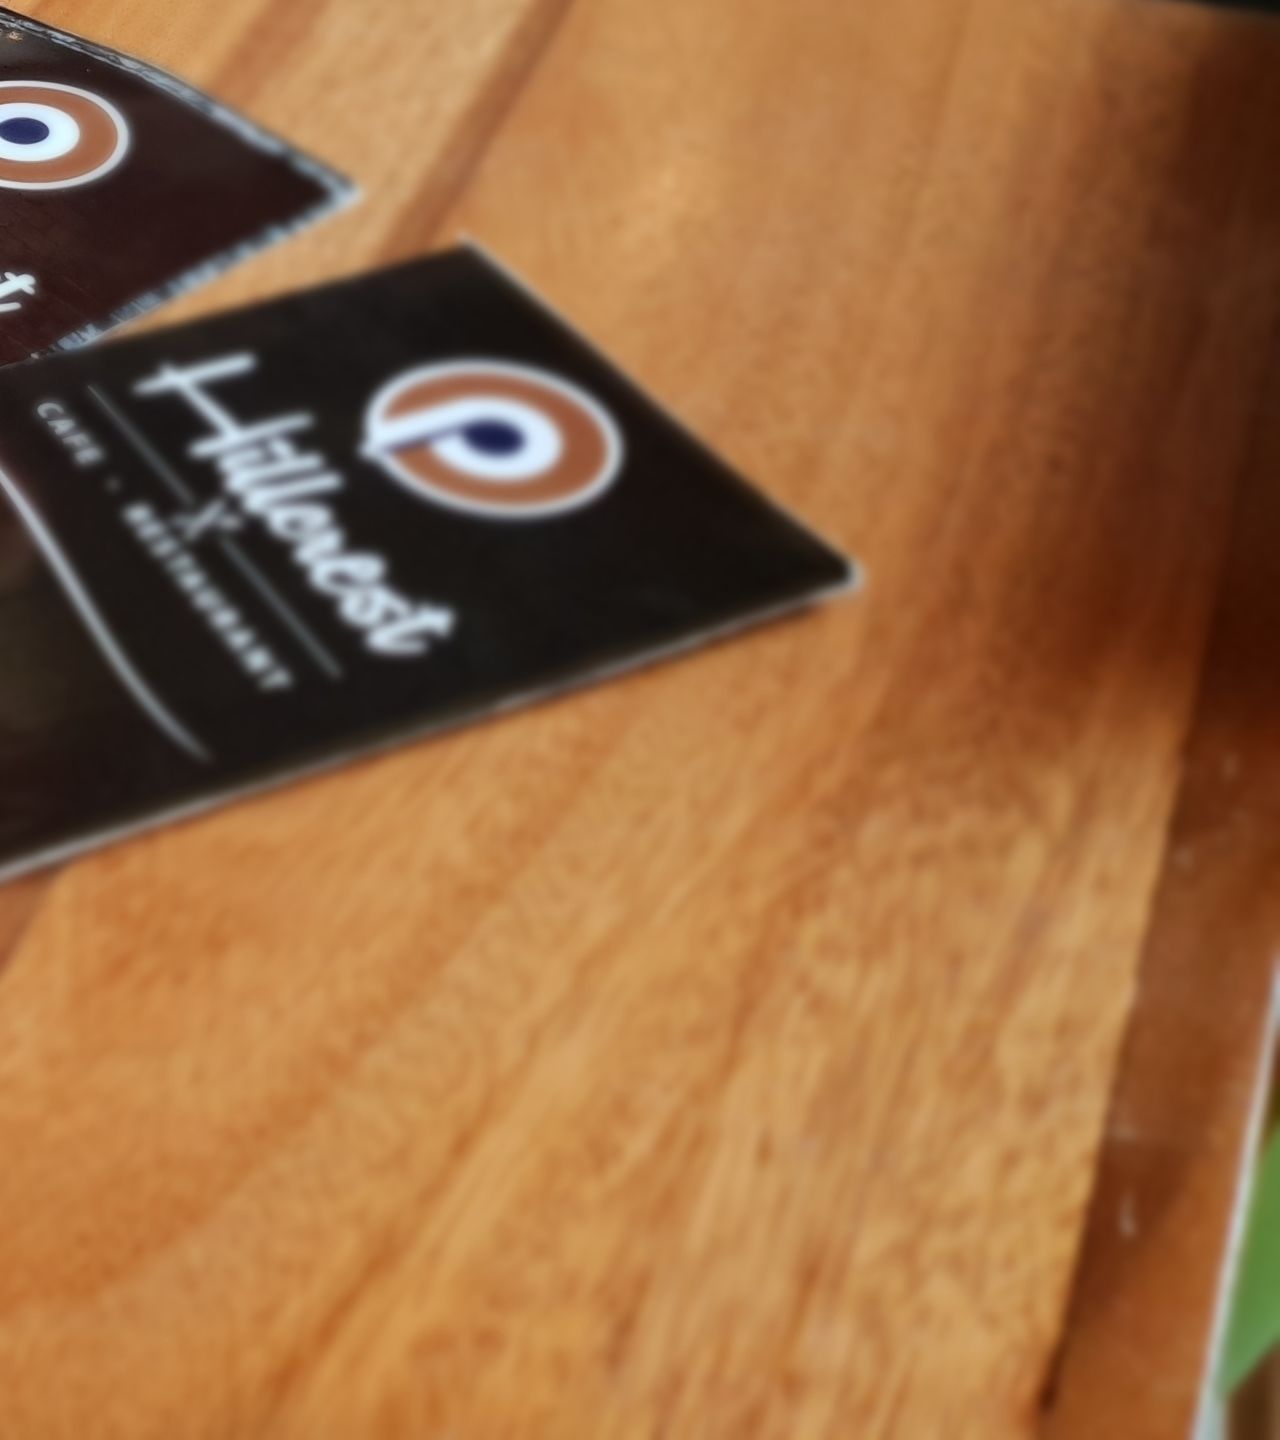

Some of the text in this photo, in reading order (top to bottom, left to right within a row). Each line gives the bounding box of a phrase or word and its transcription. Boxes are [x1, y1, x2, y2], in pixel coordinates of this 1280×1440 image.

[35, 400, 296, 693] CAFE RESTAURANT
[132, 350, 458, 657] Hillcrest
